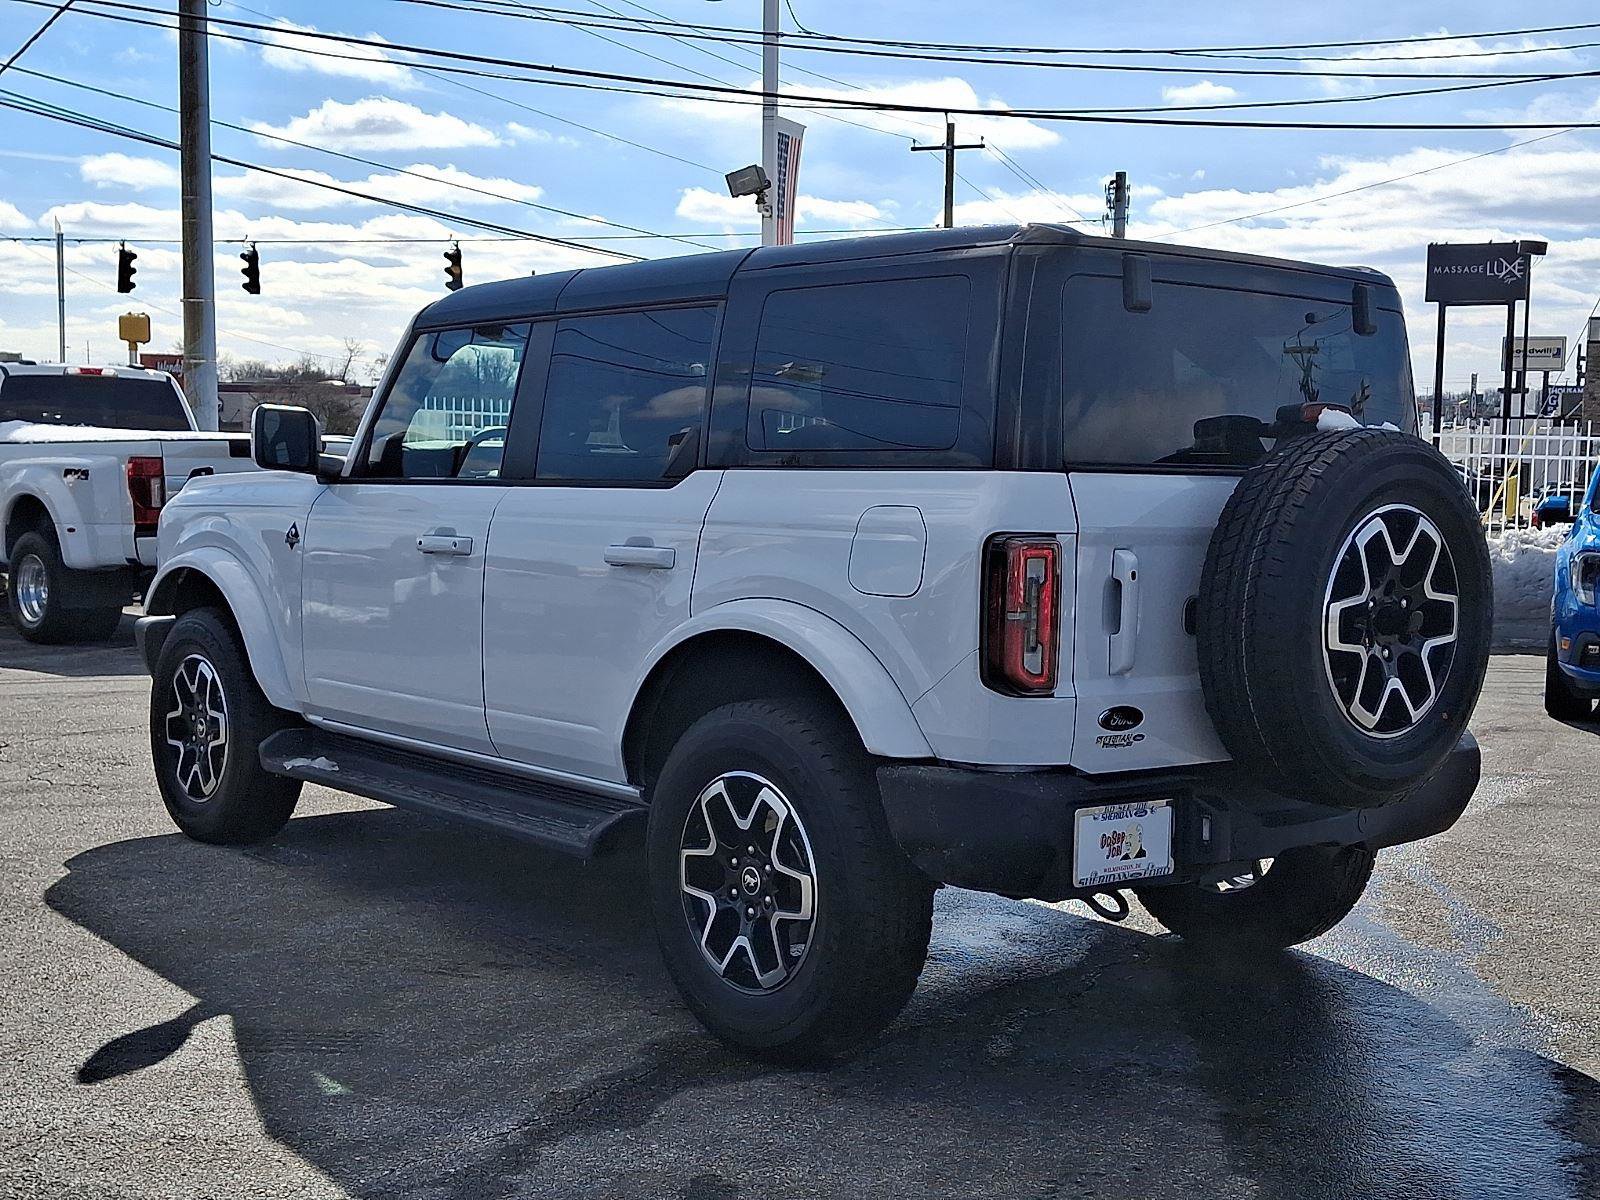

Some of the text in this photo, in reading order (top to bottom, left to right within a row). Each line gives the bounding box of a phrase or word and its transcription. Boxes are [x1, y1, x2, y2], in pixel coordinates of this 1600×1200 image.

[1433, 256, 1524, 279] MASSAGE LUXE
[1510, 346, 1552, 354] odwill
